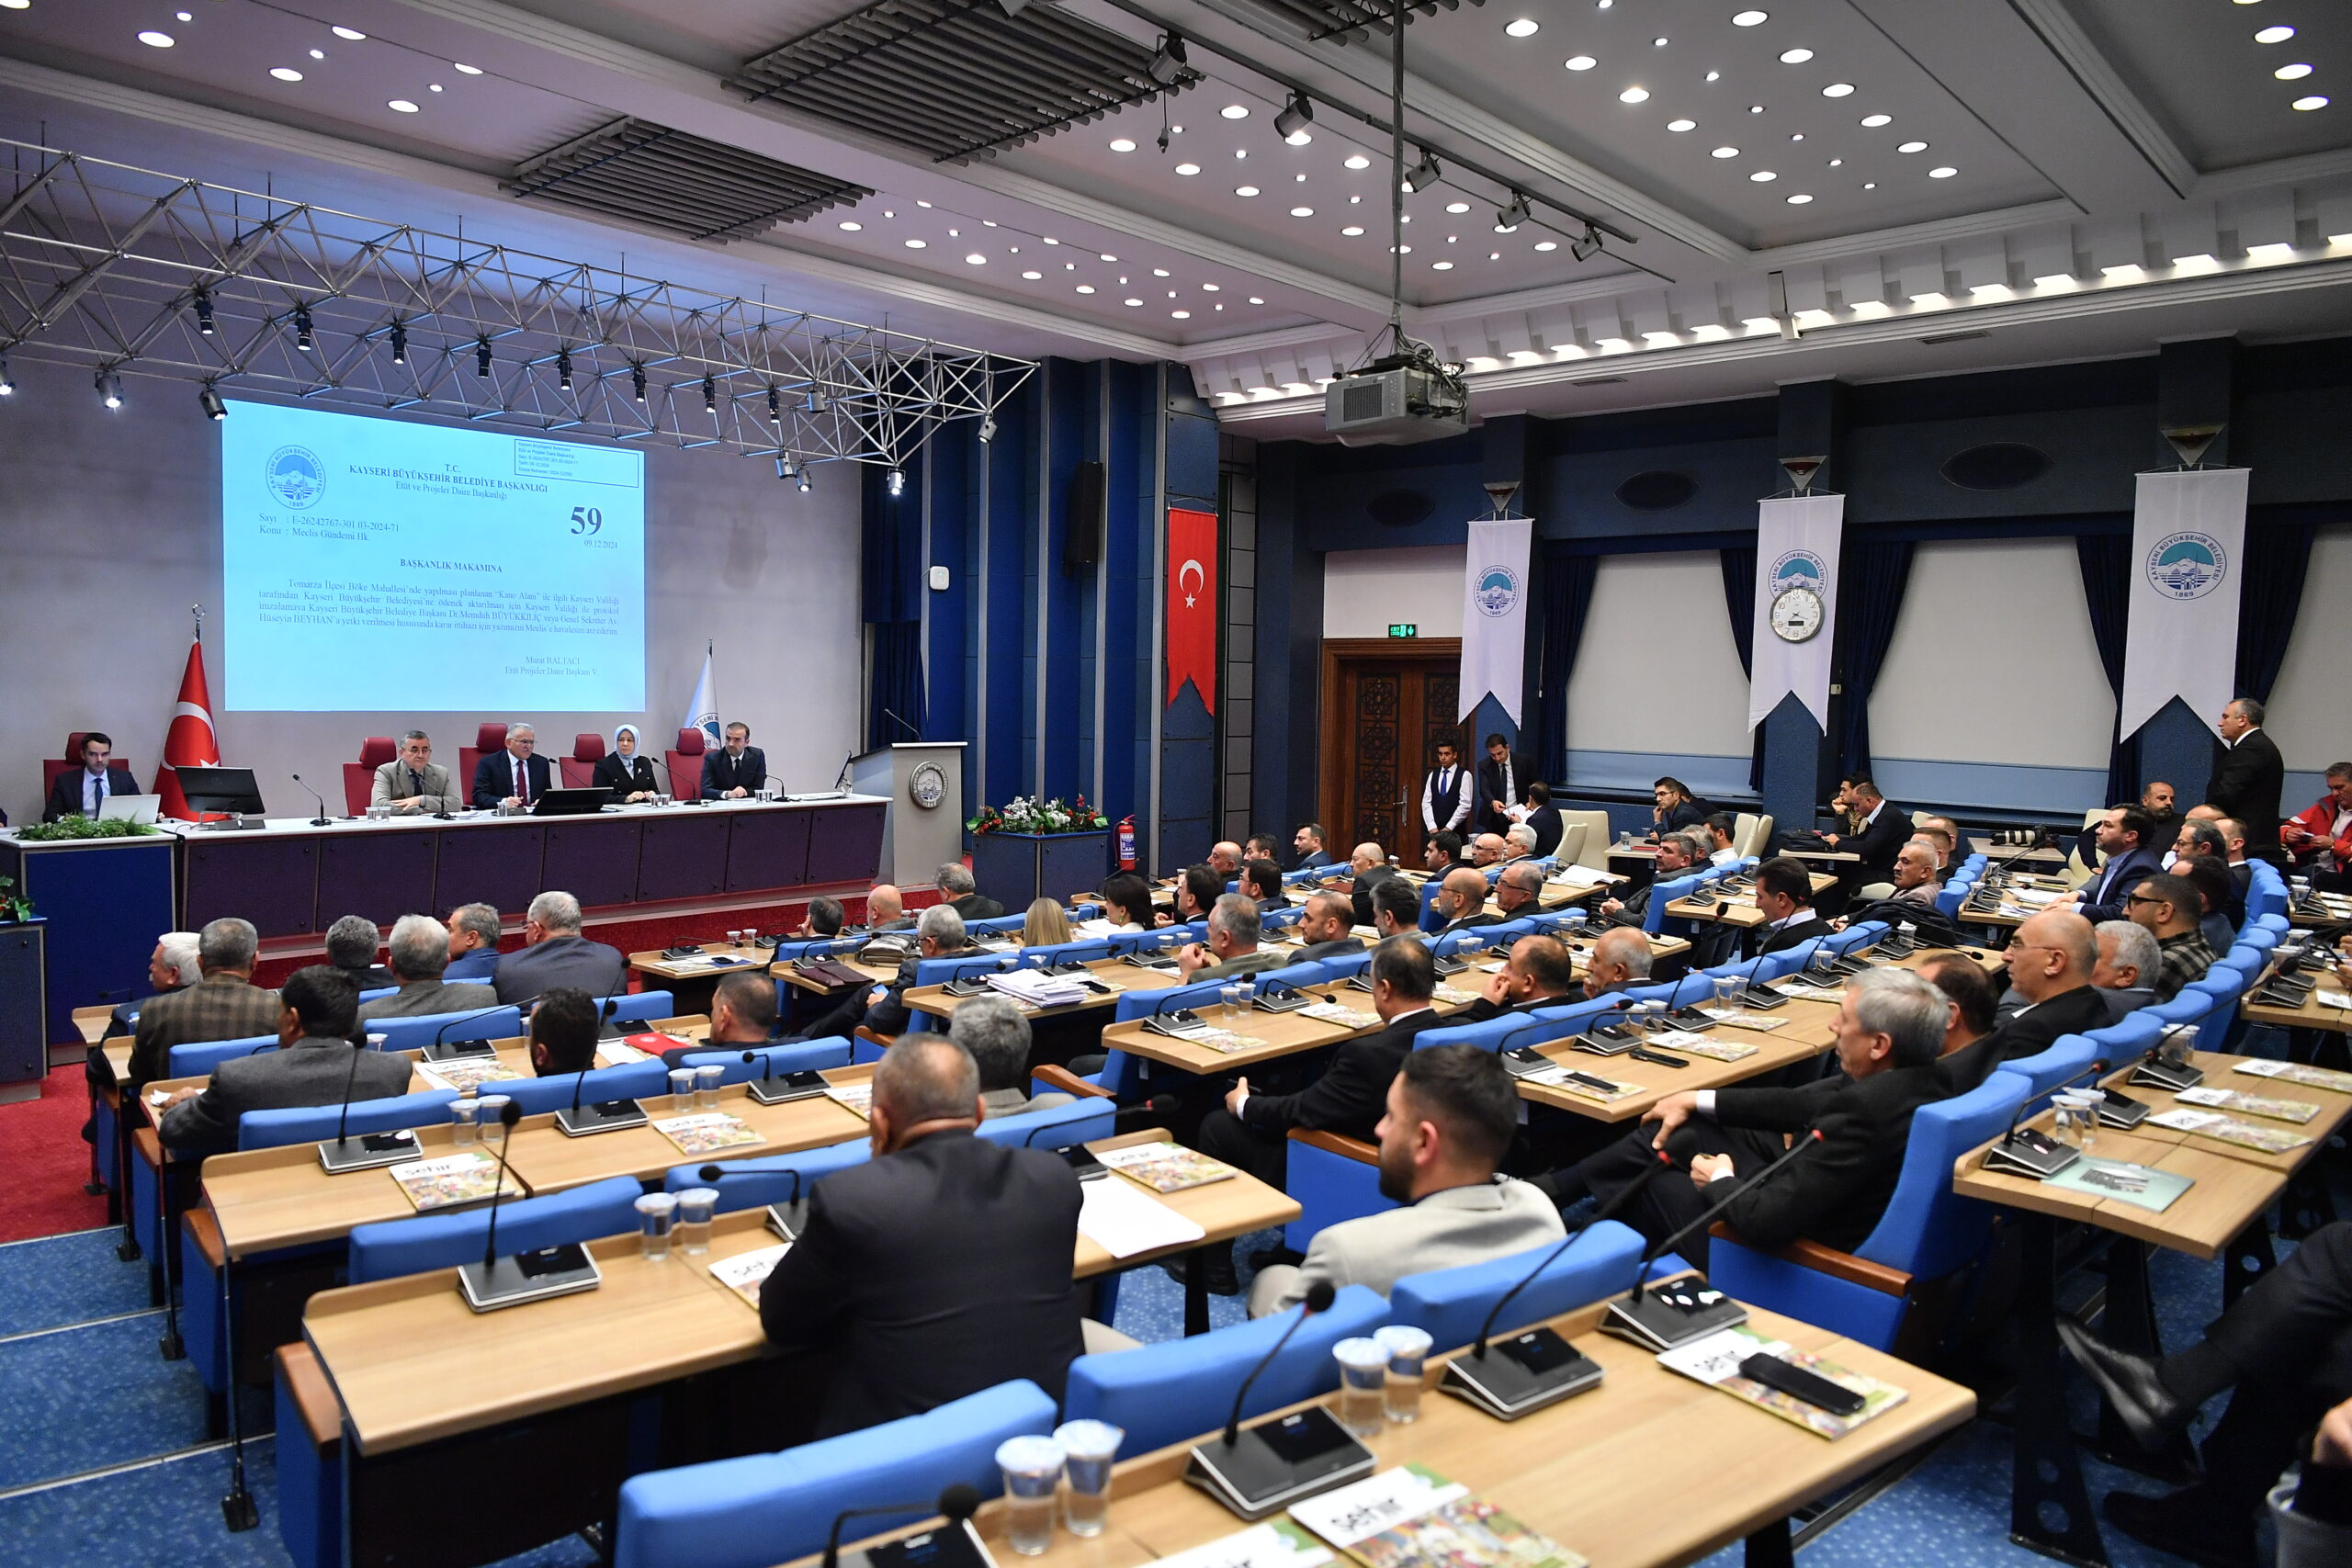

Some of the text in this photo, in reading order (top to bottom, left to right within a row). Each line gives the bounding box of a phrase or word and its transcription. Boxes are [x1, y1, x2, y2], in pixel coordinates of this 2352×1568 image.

[445, 463, 461, 473] T.C.
[349, 465, 548, 493] KAYSERİ BÜYÜKŞEHİR BELEDİYE BAŞKANLIĞI
[396, 481, 413, 491] Etüt
[423, 484, 451, 495] Projeler
[452, 487, 471, 497] Daire
[472, 489, 507, 501] Başkanlığı
[259, 513, 277, 525] Sayı
[570, 506, 603, 536] 59
[259, 525, 281, 535] Konu
[292, 527, 319, 537] Meclis
[320, 529, 356, 540] Gündemi
[400, 558, 503, 573] BAŞKANLIK MAKAMINA
[2151, 550, 2161, 581] KAYSERİ
[2208, 543, 2223, 581] BELEDİYESİ
[288, 579, 322, 589] Tomarza
[325, 580, 345, 591] İlçesi
[348, 581, 368, 592] Böke
[424, 586, 458, 597] yapılması
[460, 588, 492, 599] planlanan
[570, 594, 594, 604] Kayseri
[259, 590, 299, 600] tarafından
[304, 592, 334, 603] Kayseri
[339, 593, 381, 605] Büyükşehir
[438, 598, 463, 607] ödenek
[468, 600, 504, 610] aktarılması
[508, 602, 521, 612] için
[526, 603, 550, 613] Kayseri
[582, 605, 590, 614] ile
[259, 603, 306, 613] imzalamaya
[309, 604, 338, 614] Kayseri
[341, 604, 383, 616] Büyükşehir
[385, 606, 417, 616] Belediye
[419, 608, 447, 619] Başkanı
[544, 615, 559, 624] veya
[560, 615, 580, 624] Genel
[259, 613, 292, 624] Hüseyin
[341, 616, 360, 626] yetki
[361, 617, 395, 626] verilmesi
[397, 619, 434, 628] hususunda
[526, 655, 545, 664] Murat
[520, 667, 546, 676] Projeler
